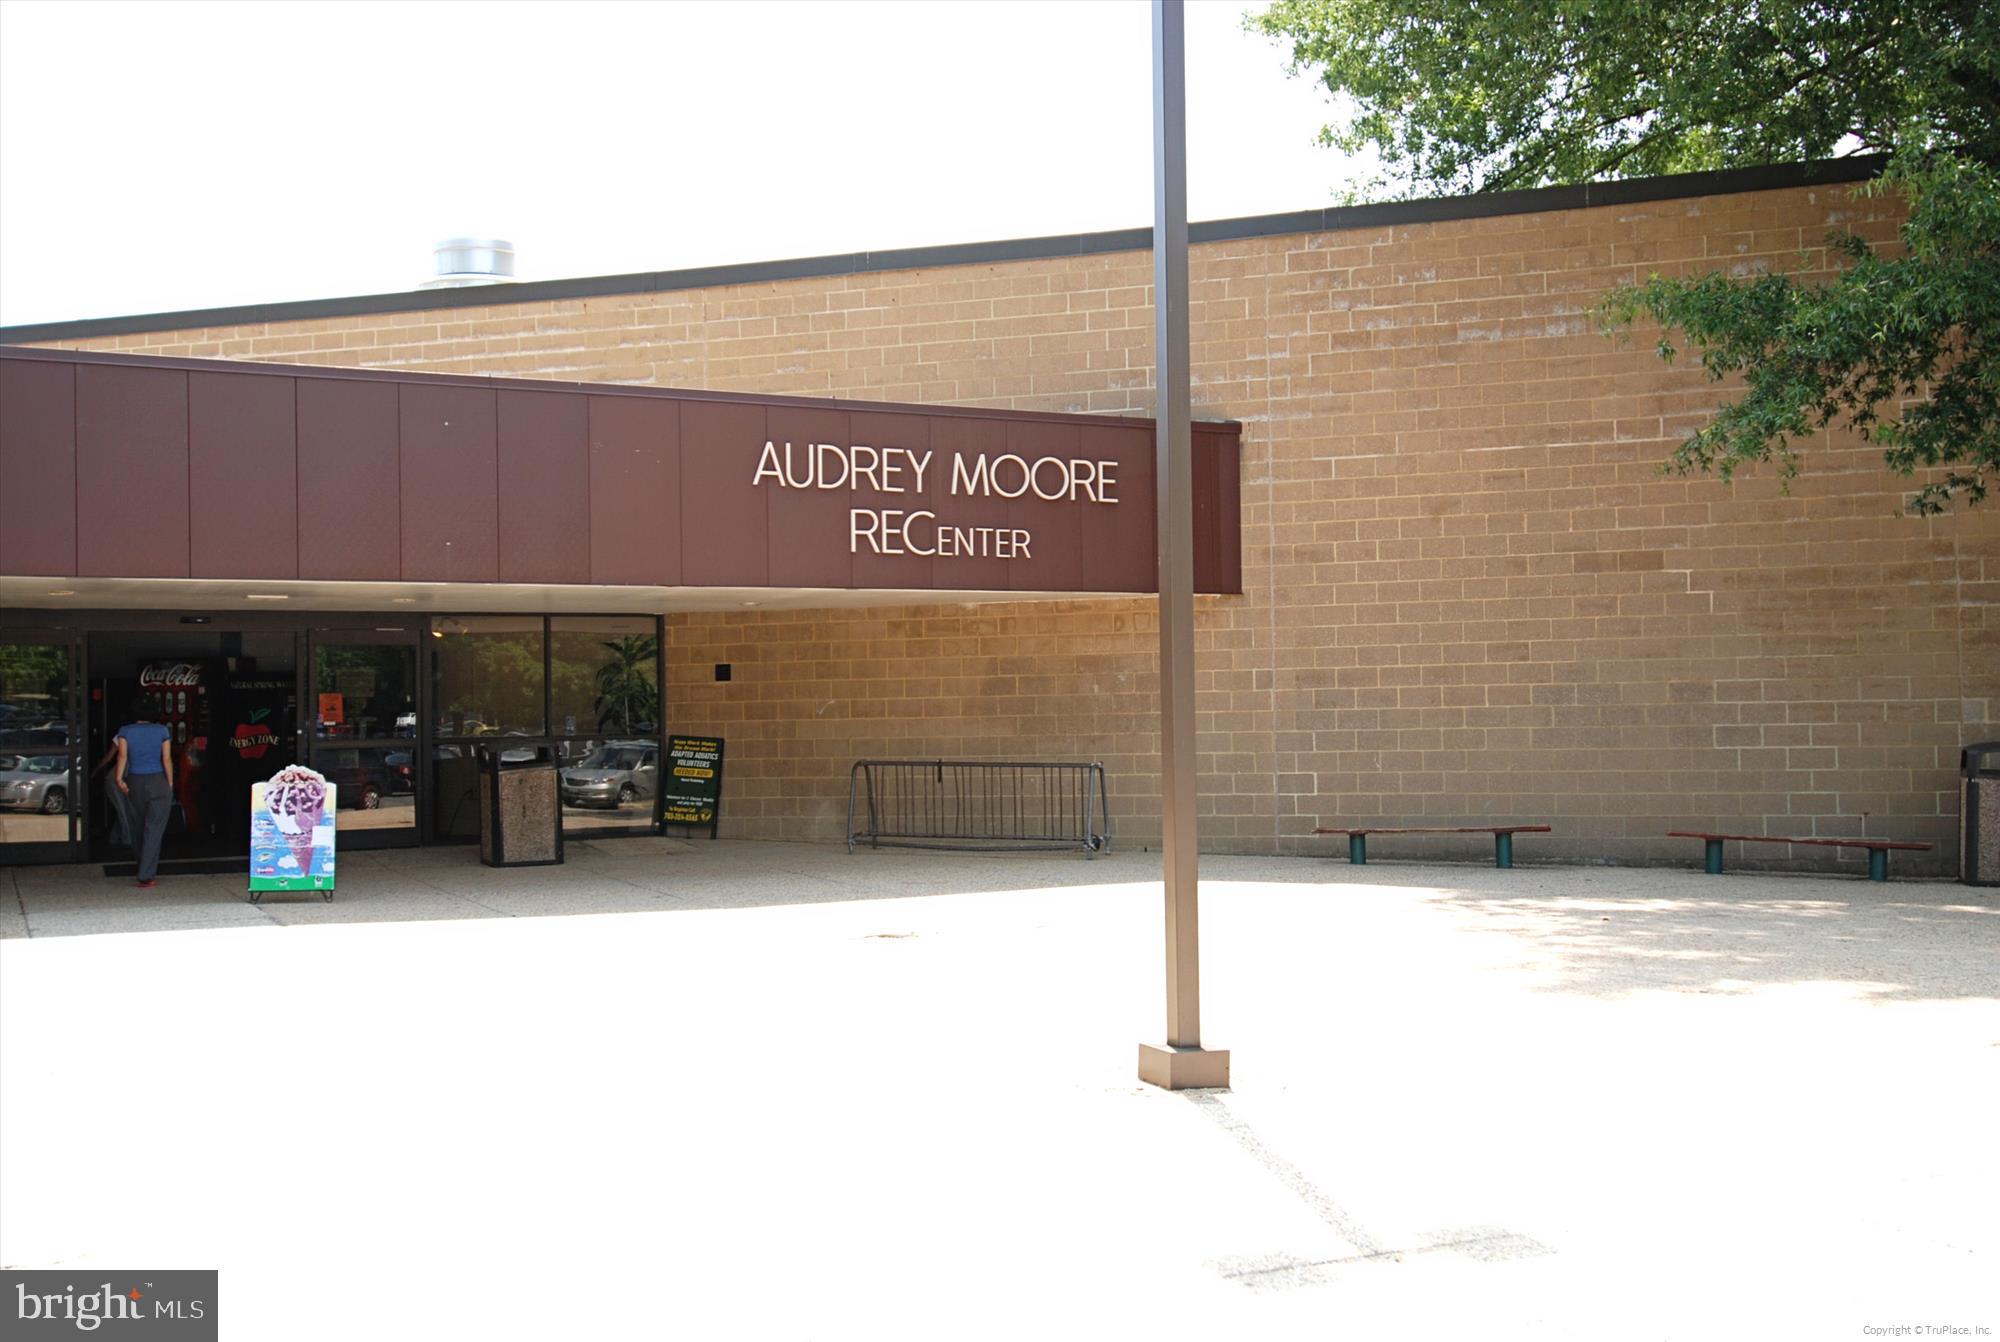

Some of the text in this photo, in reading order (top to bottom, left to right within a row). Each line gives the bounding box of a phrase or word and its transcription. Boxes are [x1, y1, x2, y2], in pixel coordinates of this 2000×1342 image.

[752, 441, 1119, 503] AUDREY MOORE
[228, 734, 281, 749] ENERGY ZONE
[671, 750, 719, 760] ADAPTED AQUATICS
[677, 759, 710, 768] VOLUNTEERS
